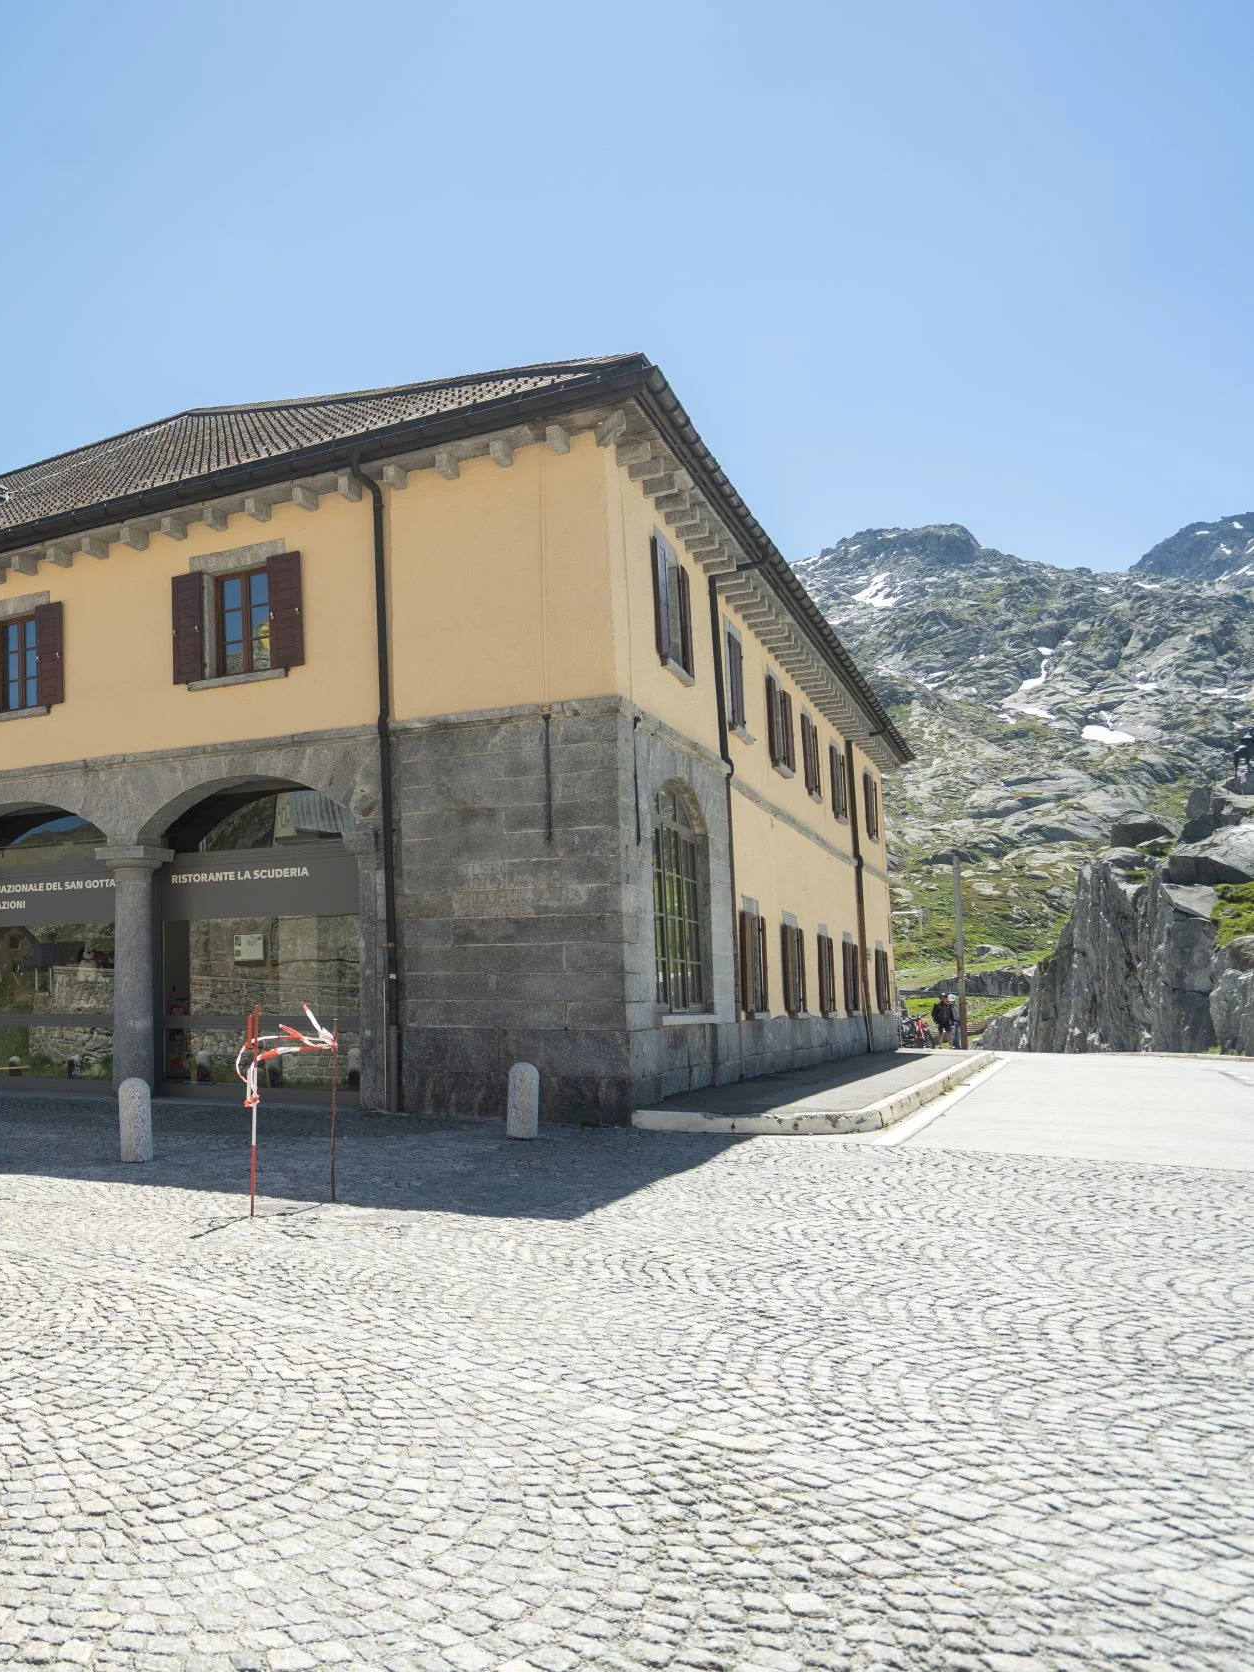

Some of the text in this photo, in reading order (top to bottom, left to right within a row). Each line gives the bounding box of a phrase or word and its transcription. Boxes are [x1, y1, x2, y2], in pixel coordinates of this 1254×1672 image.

[171, 866, 309, 884] RISTORANTE LA SCUDERIA
[46, 881, 63, 891] DEL
[64, 880, 83, 890] SAN
